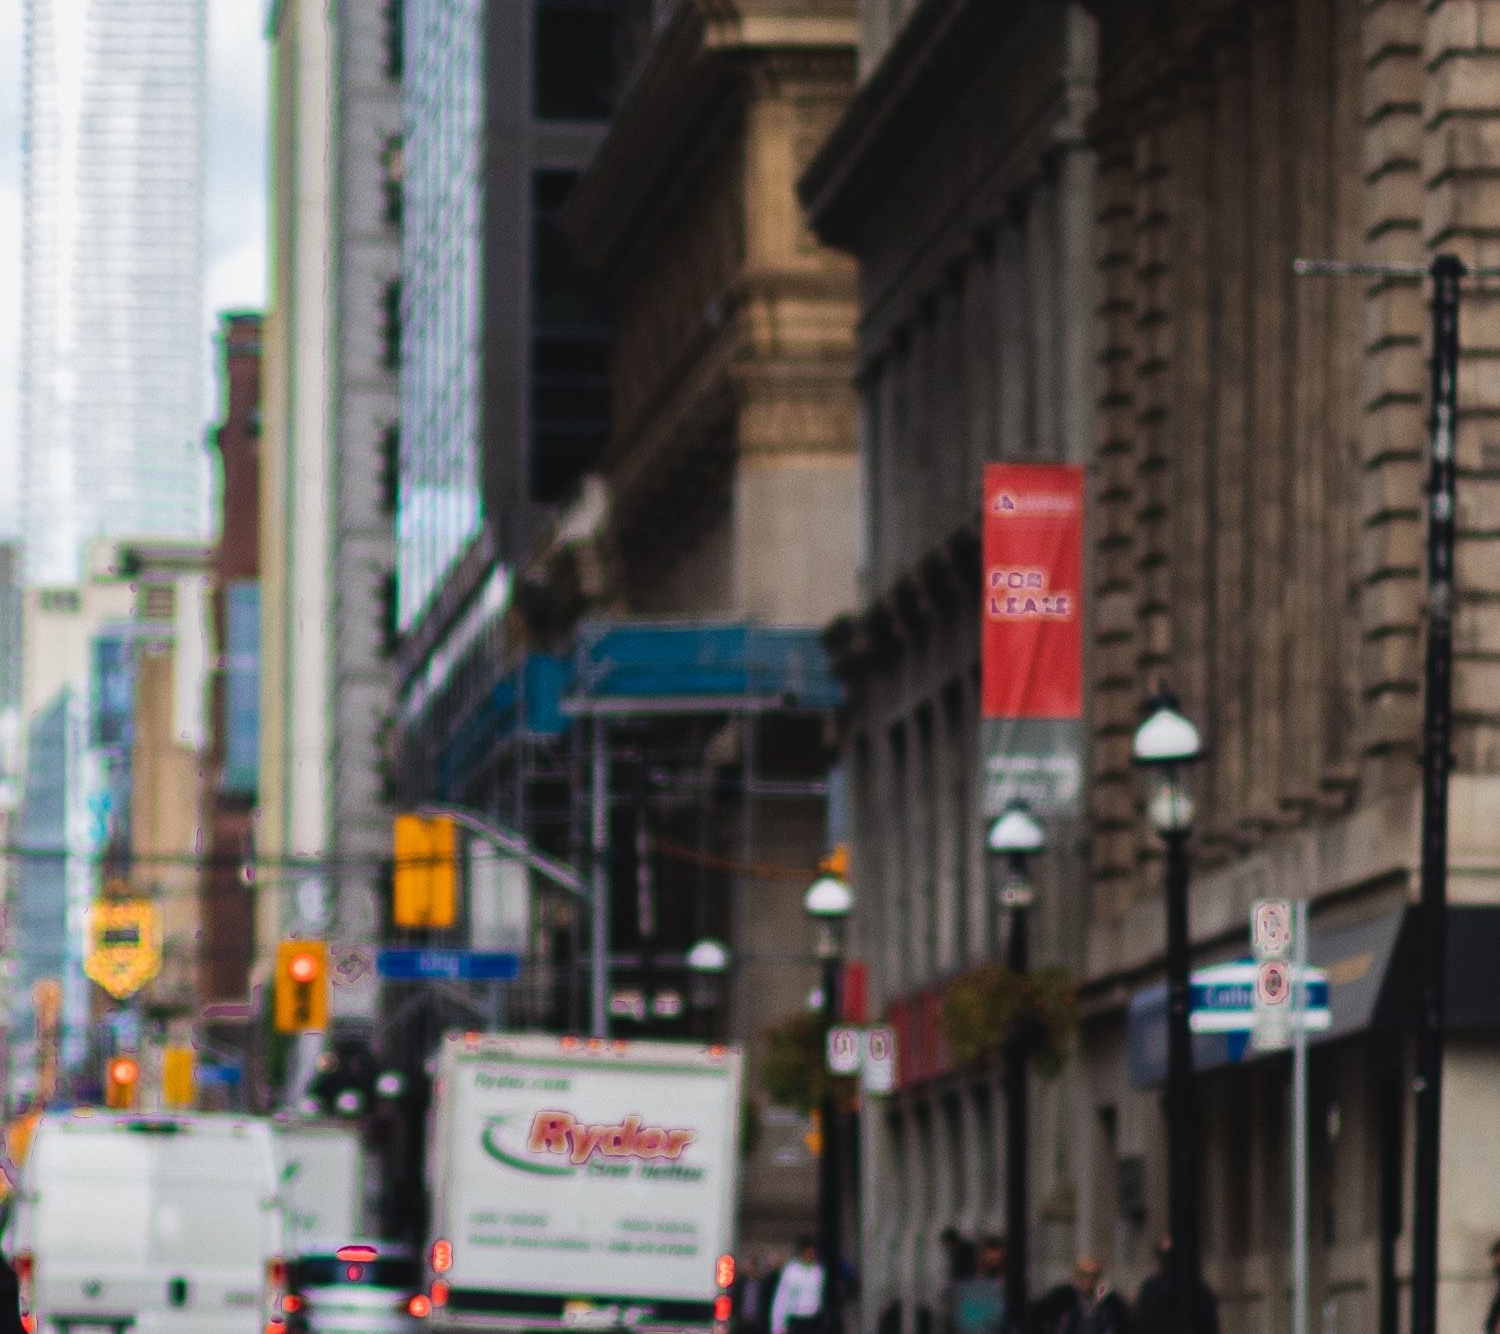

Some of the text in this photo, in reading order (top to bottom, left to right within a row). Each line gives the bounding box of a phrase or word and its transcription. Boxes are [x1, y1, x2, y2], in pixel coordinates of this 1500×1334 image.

[990, 570, 1043, 590] FOR
[989, 594, 1069, 615] LEASE
[526, 1110, 697, 1165] Ryder
